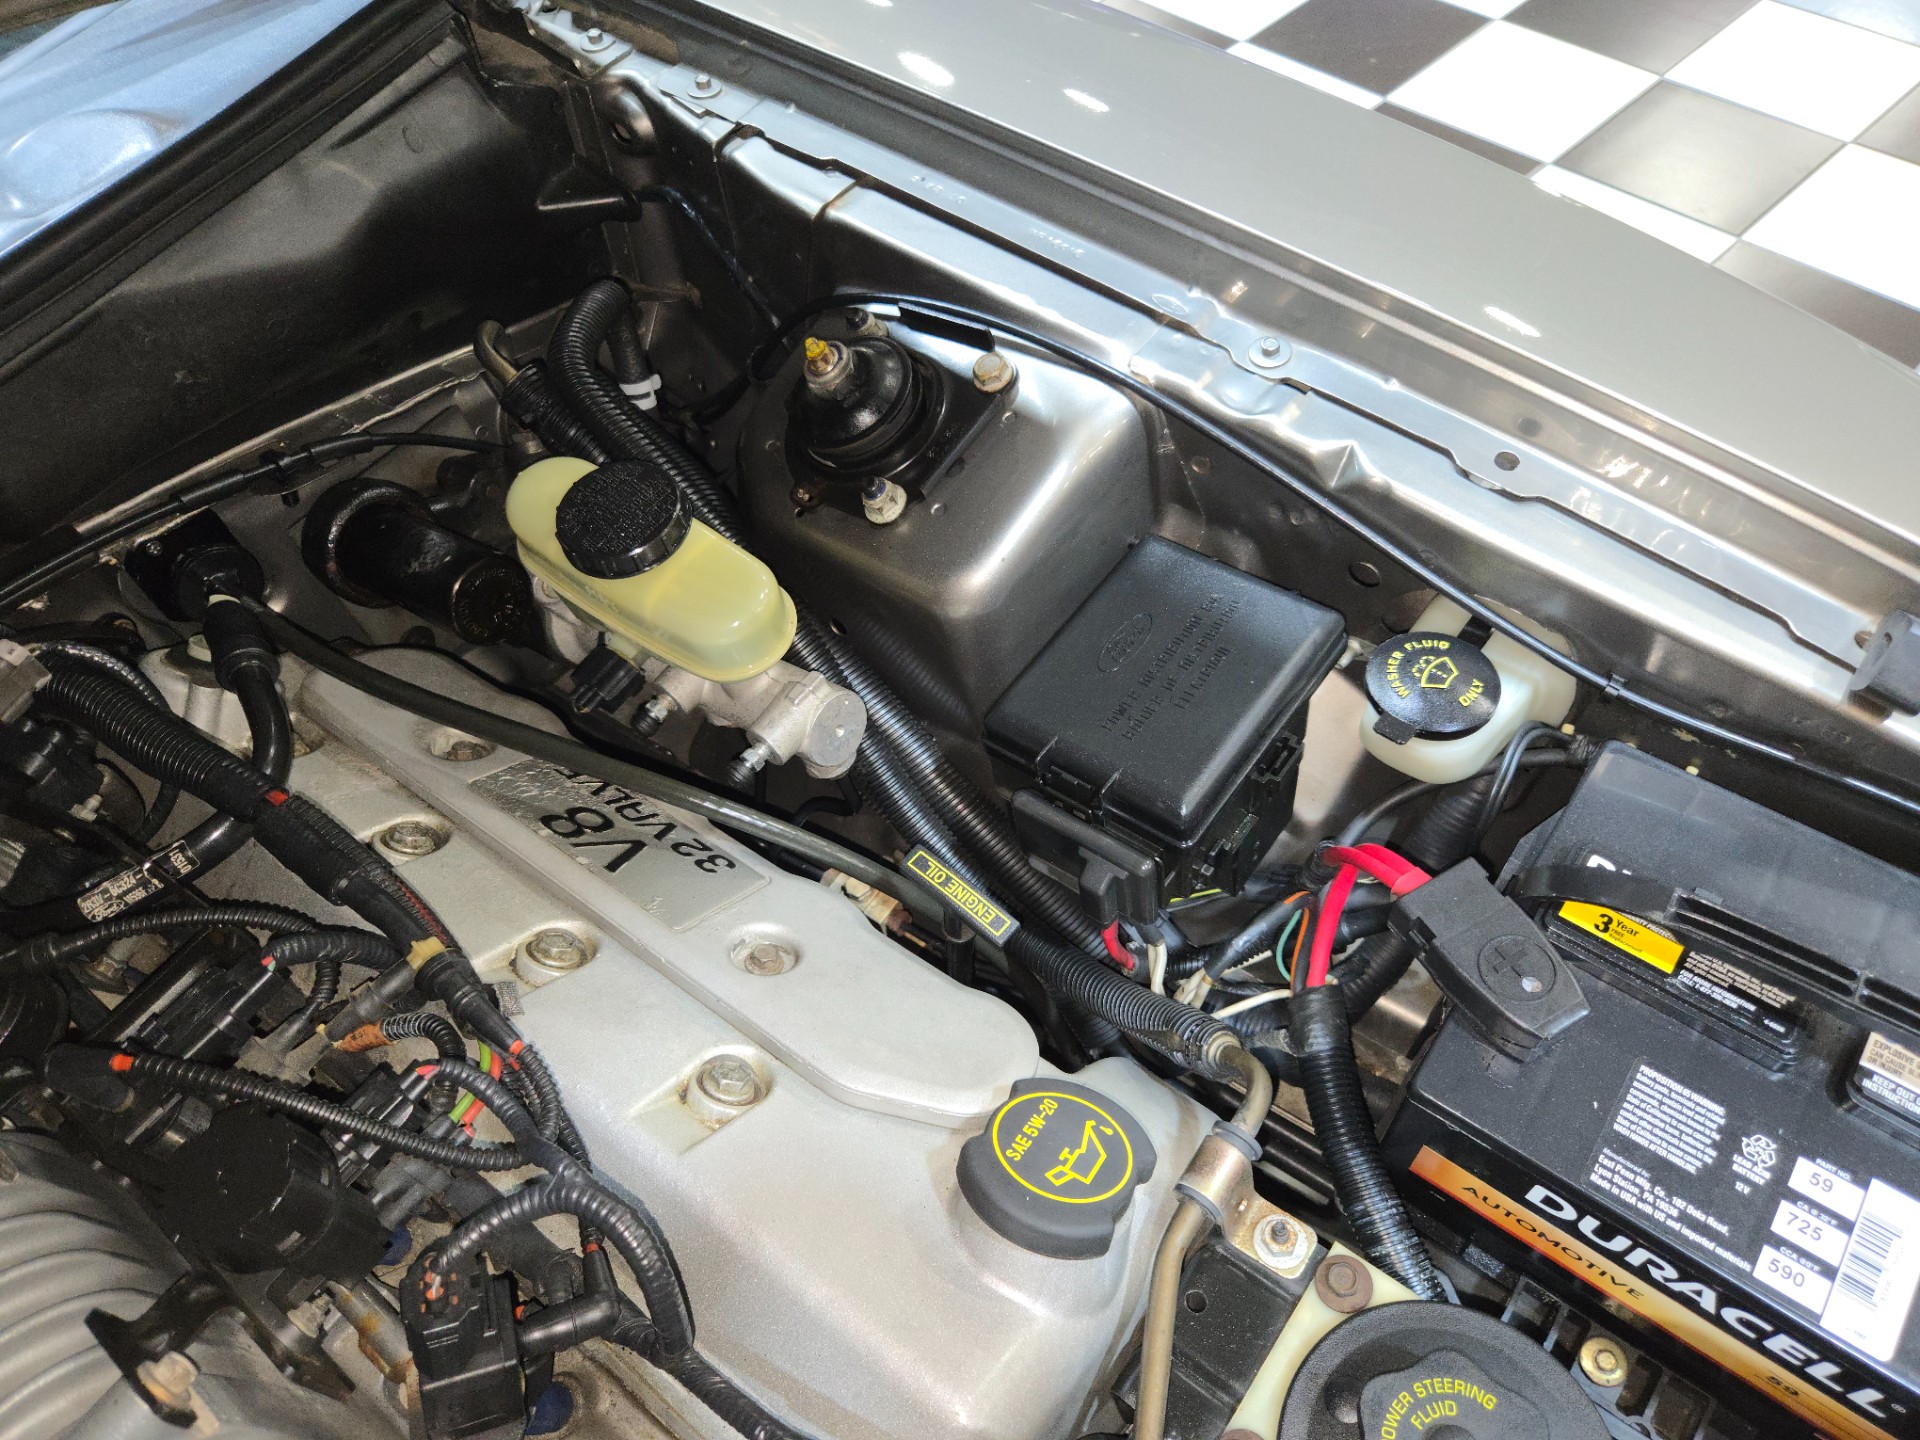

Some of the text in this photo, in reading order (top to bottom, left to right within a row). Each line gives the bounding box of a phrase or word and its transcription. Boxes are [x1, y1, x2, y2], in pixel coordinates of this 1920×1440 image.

[1386, 639, 1485, 707] WASHER FLUID ONLY
[540, 806, 649, 873] V8
[671, 838, 737, 874] 32
[925, 861, 996, 923] ENGINE OIL
[1594, 913, 1640, 937] 3 Year
[1680, 969, 1694, 979] FOR
[1692, 974, 1713, 989] MORE
[1710, 985, 1757, 1011] INFORMATION
[1867, 1055, 1877, 1064] OR
[1870, 1049, 1884, 1059] CAN
[1884, 1055, 1906, 1072] CAUSE
[1873, 1040, 1914, 1066] EXPLOSIVE
[1639, 1064, 1683, 1092] PROPOSITION
[1872, 1074, 1897, 1090] KEEP
[1895, 1086, 1916, 1101] OUT
[1005, 1098, 1058, 1161] SAE 5W-20
[1732, 1153, 1753, 1168] LEAD
[1732, 1162, 1765, 1184] BATTERY
[1815, 1157, 1836, 1172] PART
[1593, 1164, 1613, 1180] Lyon
[1641, 1191, 1655, 1203] PA
[1654, 1198, 1679, 1217] 19536
[1597, 1154, 1615, 1169] East
[1614, 1164, 1635, 1180] Penn
[1670, 1195, 1686, 1209] 102
[1808, 1170, 1834, 1193] 59
[1795, 1200, 1809, 1212] CA
[1589, 1172, 1752, 1271] Made in USA with US and imported materials
[1784, 1211, 1824, 1241] 725
[1462, 1187, 1645, 1300] AUTOMOTIVE
[1778, 1245, 1798, 1260] CCA
[1767, 1256, 1807, 1287] 590
[1525, 1184, 1887, 1418] DURACELL
[1766, 1375, 1799, 1396] 59
[1381, 1377, 1497, 1440] OWER STEERING
[1410, 1400, 1457, 1430] FLUID
